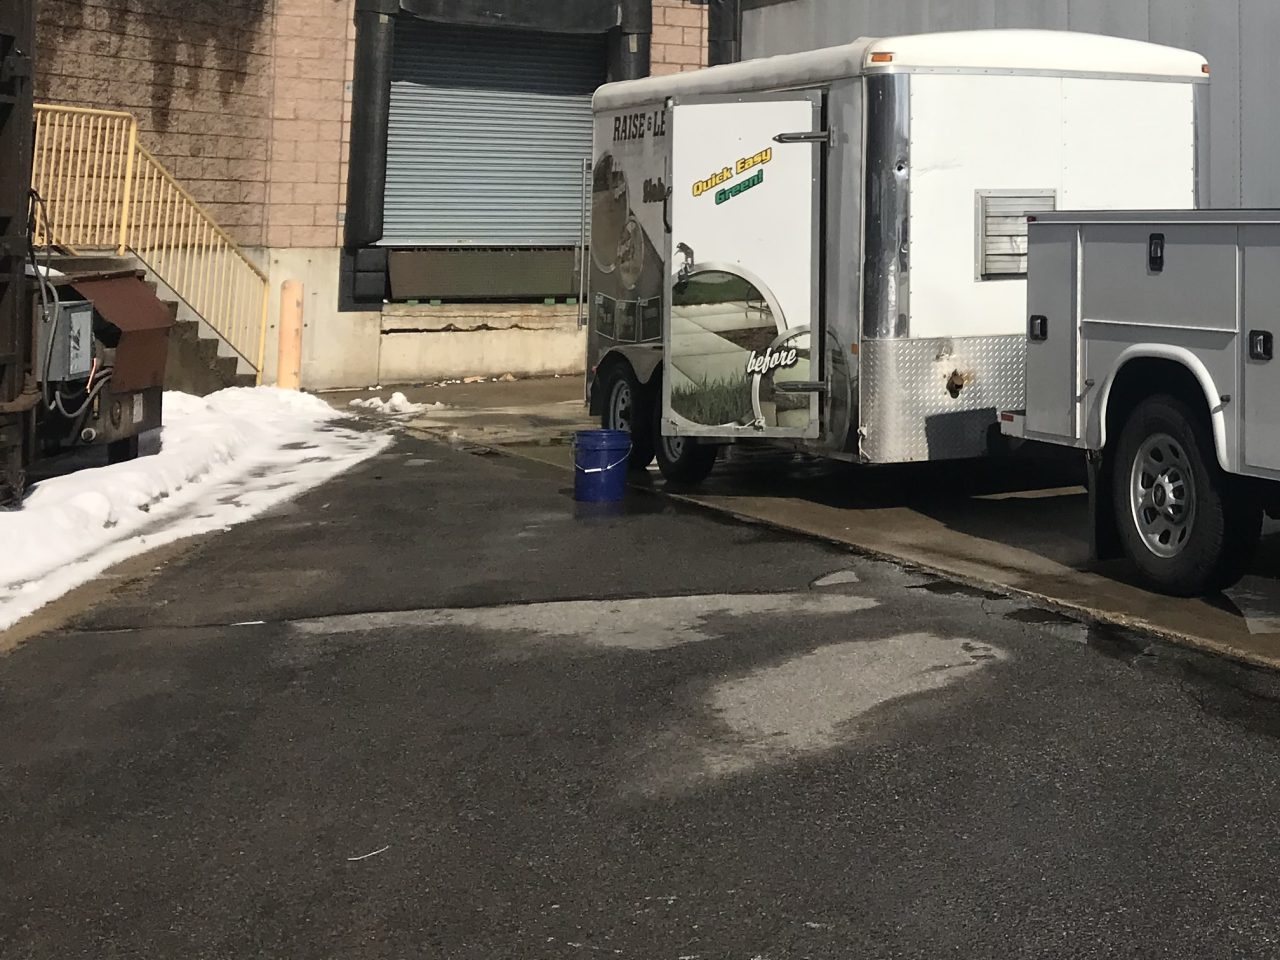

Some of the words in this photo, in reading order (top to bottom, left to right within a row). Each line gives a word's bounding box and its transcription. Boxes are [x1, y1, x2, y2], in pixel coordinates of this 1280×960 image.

[612, 112, 646, 142] RAISE
[692, 165, 733, 197] Quick
[735, 146, 773, 175] Easy
[714, 168, 764, 206] Green!
[746, 347, 797, 374] before
